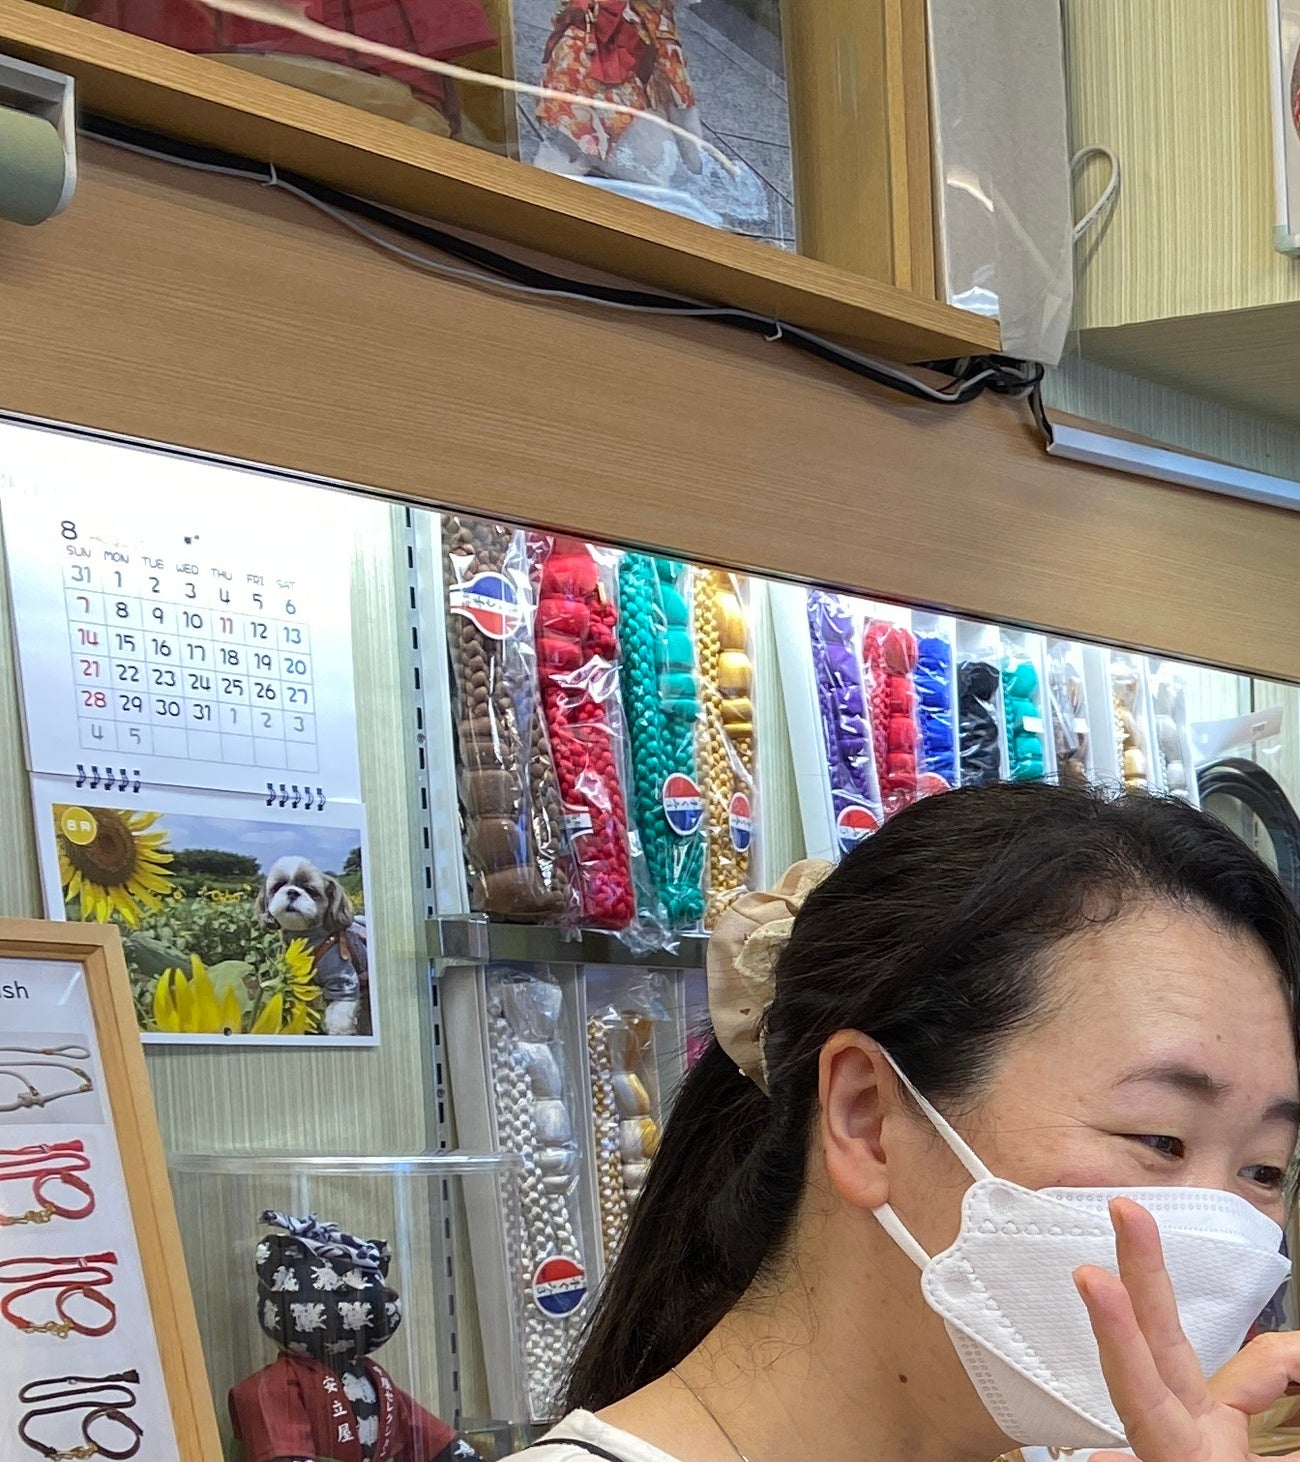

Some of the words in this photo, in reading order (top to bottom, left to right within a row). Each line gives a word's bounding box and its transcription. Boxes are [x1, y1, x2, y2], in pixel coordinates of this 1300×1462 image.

[61, 520, 77, 540] 8
[66, 545, 91, 558] SUN
[104, 551, 129, 563] MON
[141, 556, 164, 569] TUE
[176, 563, 199, 575] WED
[211, 568, 232, 581] THU
[246, 574, 264, 586] FRI
[71, 564, 91, 583] 31
[114, 571, 122, 587] 1
[149, 577, 160, 593] 2
[185, 582, 196, 599] 3
[219, 587, 230, 604] 4
[252, 593, 263, 609] 5
[285, 599, 296, 615] 6
[77, 596, 89, 613] 7
[116, 602, 129, 618] 8
[152, 607, 164, 624] 9
[182, 611, 203, 629] 10
[219, 617, 233, 634] 11
[250, 622, 268, 639] 12
[283, 627, 301, 644] 13
[77, 628, 99, 646] 14
[115, 633, 135, 652] 15
[151, 638, 172, 656] 16
[187, 643, 205, 661] 17
[220, 648, 239, 665] 18
[254, 653, 272, 671] 19
[284, 658, 306, 675] 20
[79, 659, 99, 678] 21
[115, 664, 139, 682] 22
[152, 669, 176, 687] 23
[188, 674, 211, 691] 24
[221, 678, 244, 696] 25
[254, 682, 276, 700] 26
[286, 687, 308, 704] 27
[81, 690, 107, 708] 28
[119, 695, 142, 713] 29
[155, 699, 181, 717] 30
[193, 704, 211, 721] 31
[230, 707, 237, 724] 1
[261, 712, 271, 728] 2
[294, 716, 304, 732] 3
[91, 723, 104, 740] 4
[129, 728, 141, 744] 5
[322, 1375, 354, 1443] 安立屋
